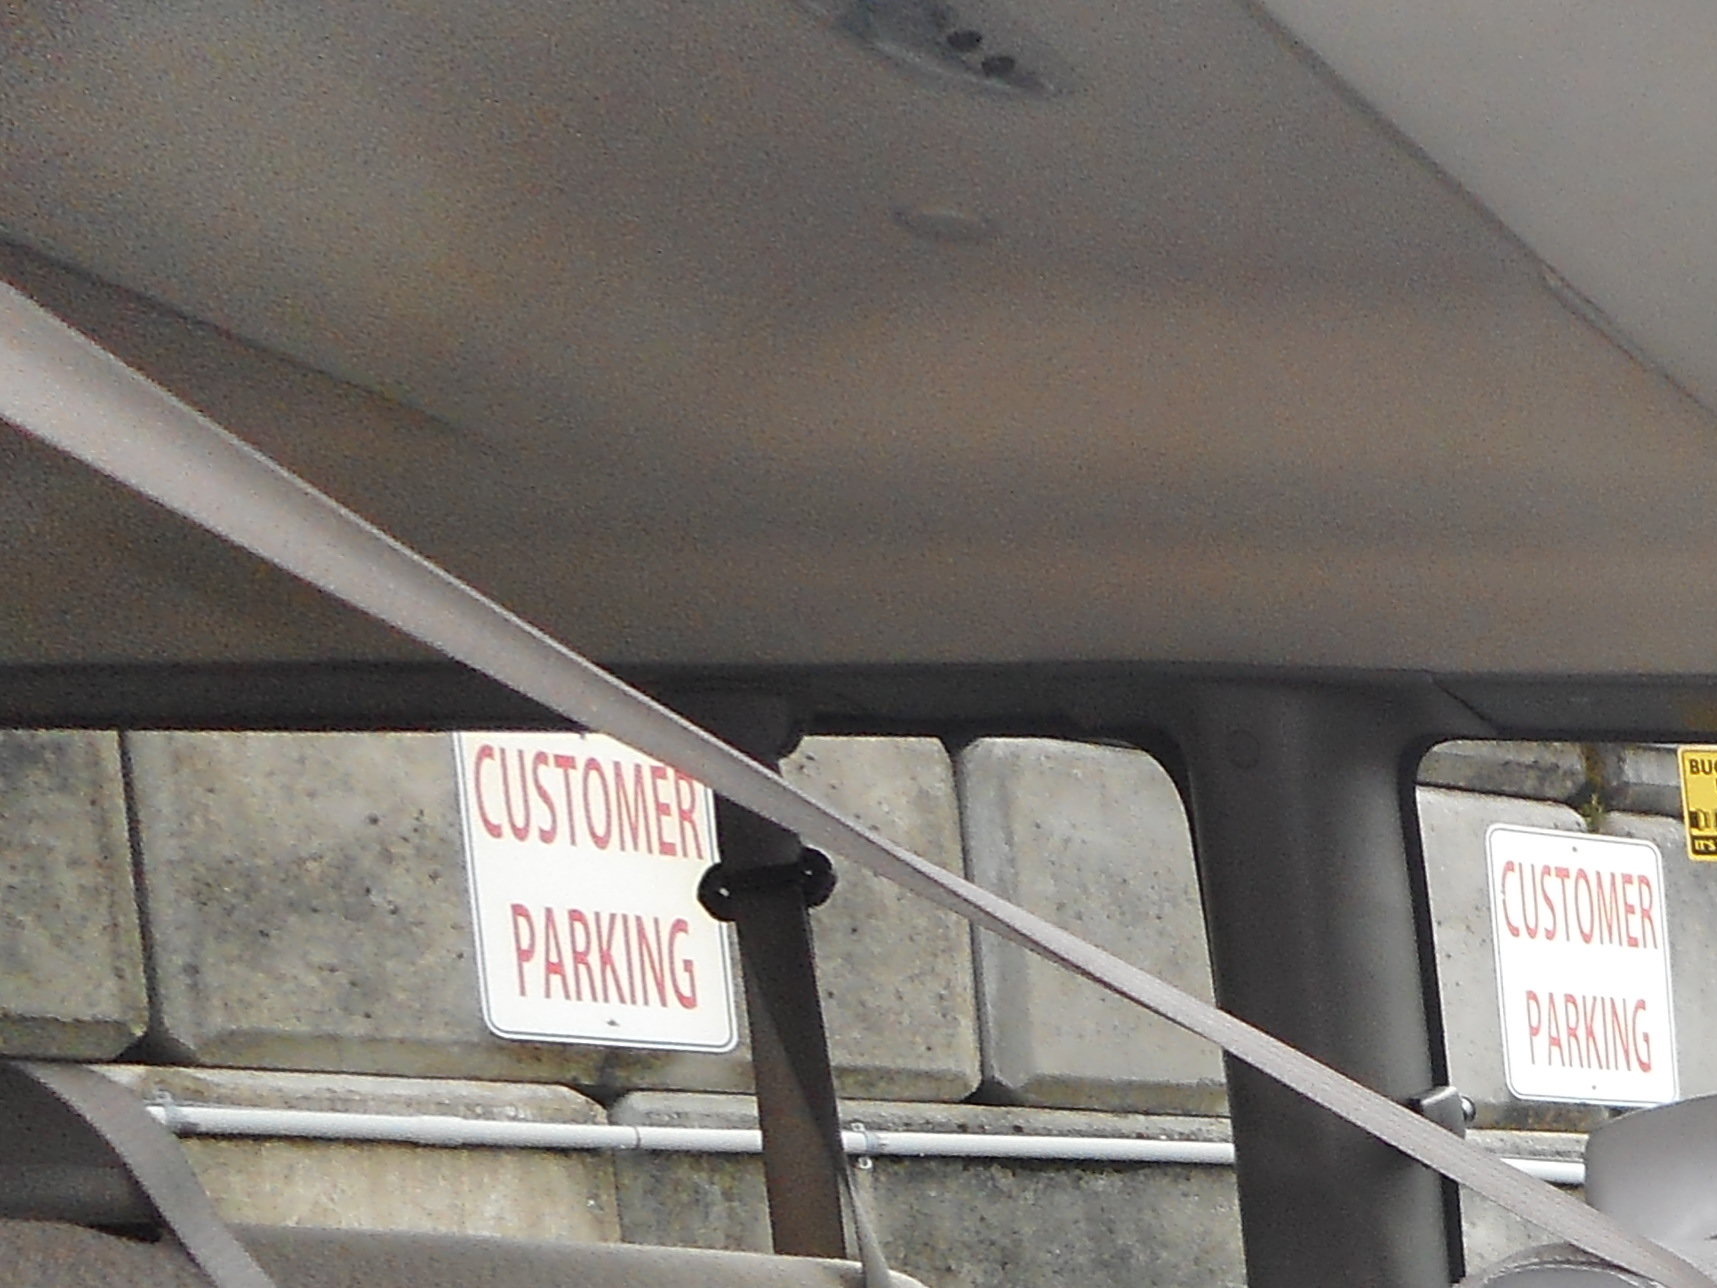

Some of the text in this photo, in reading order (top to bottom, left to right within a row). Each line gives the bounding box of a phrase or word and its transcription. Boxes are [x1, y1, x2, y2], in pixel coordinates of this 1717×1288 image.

[474, 744, 704, 860] CUSTOMER
[1501, 860, 1657, 949] CUSTOMER
[511, 903, 697, 1010] PARKING
[1526, 990, 1652, 1073] PARKING
